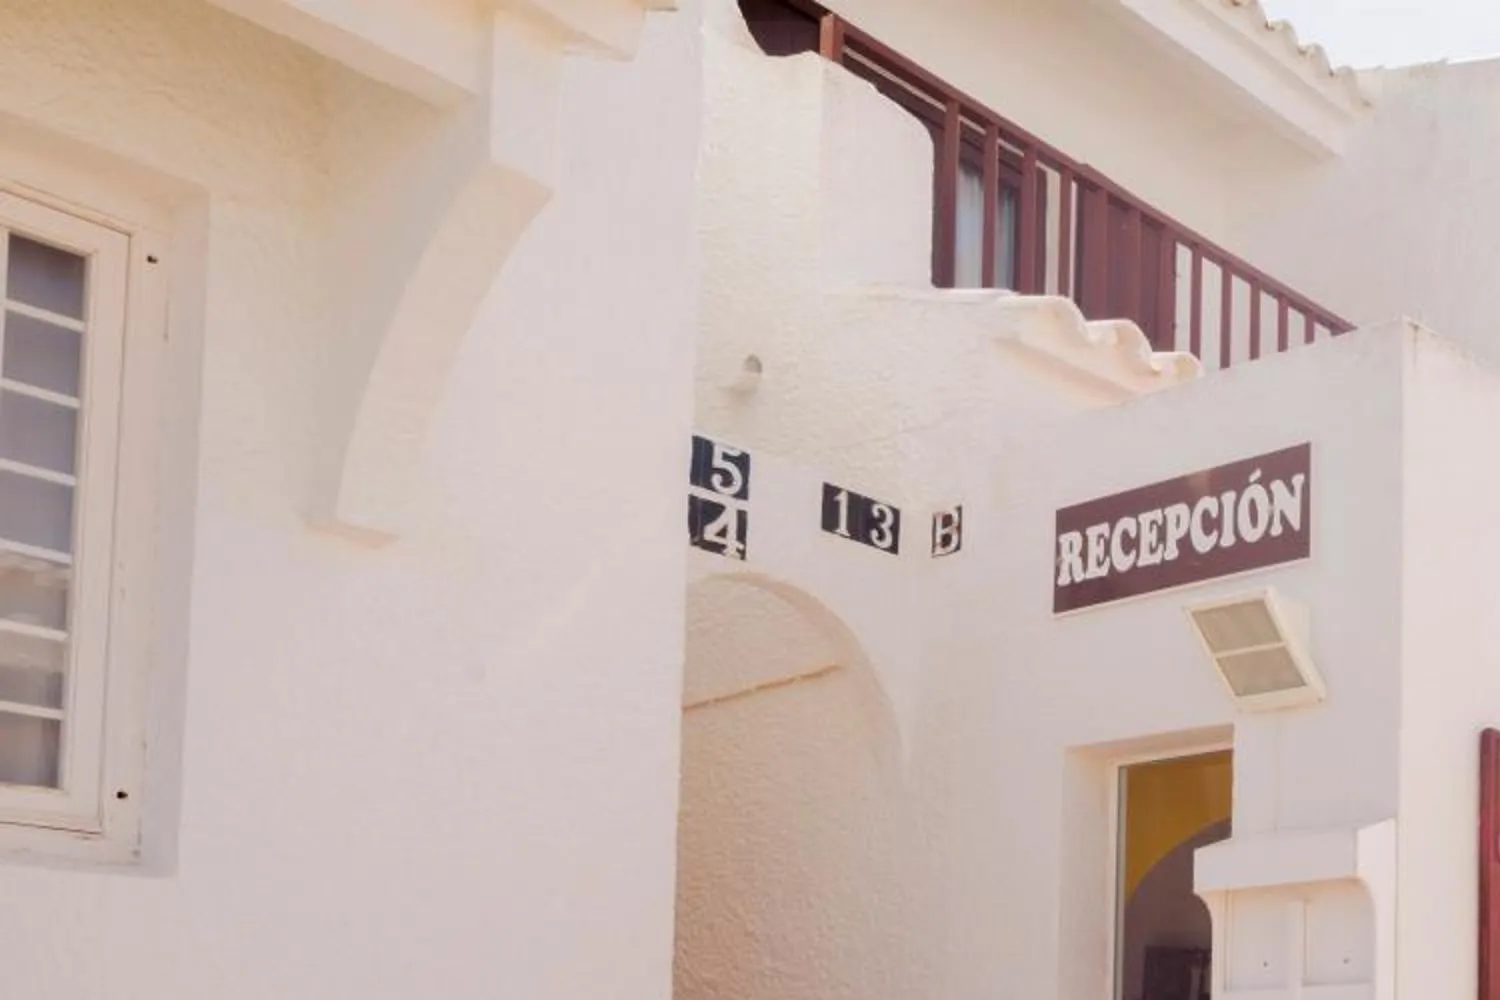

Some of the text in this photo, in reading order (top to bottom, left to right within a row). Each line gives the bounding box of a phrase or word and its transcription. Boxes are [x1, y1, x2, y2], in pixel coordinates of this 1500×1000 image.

[711, 443, 744, 496] 5
[703, 503, 745, 558] 4
[834, 490, 894, 549] 13
[1057, 468, 1305, 587] RECEPCIÓN
